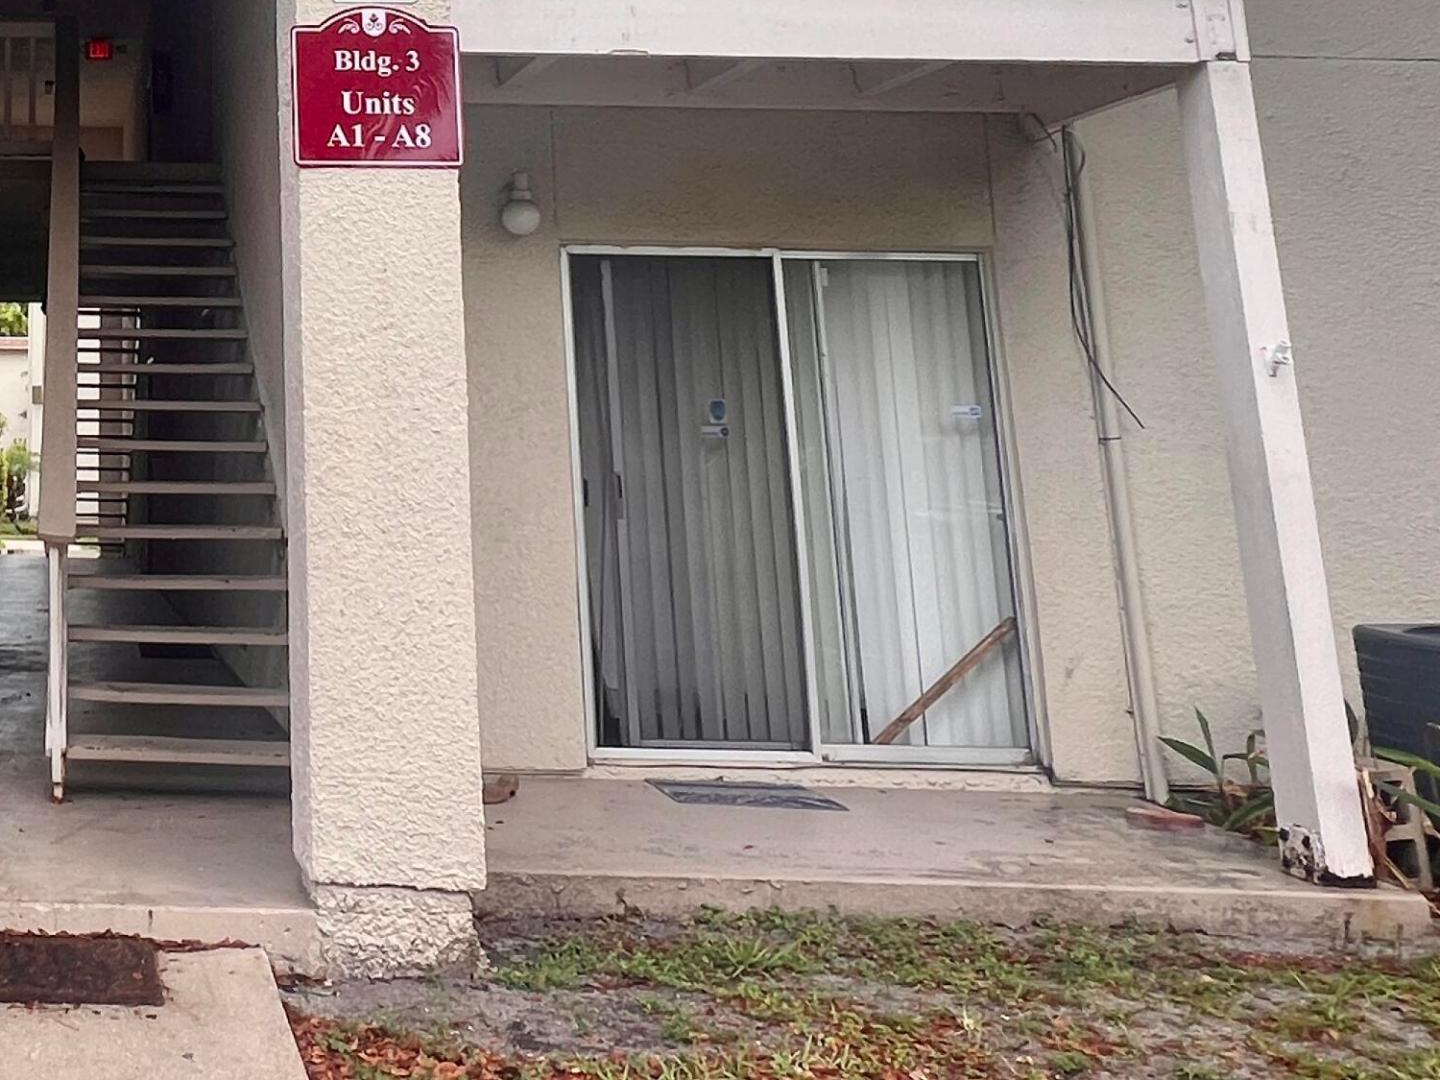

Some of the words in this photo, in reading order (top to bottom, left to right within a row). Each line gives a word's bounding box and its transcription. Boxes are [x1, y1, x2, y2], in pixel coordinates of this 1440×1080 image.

[334, 50, 399, 77] Bldg.
[405, 50, 420, 71] 3
[341, 91, 415, 115] Units
[327, 124, 364, 148] A1
[392, 123, 432, 148] A8
